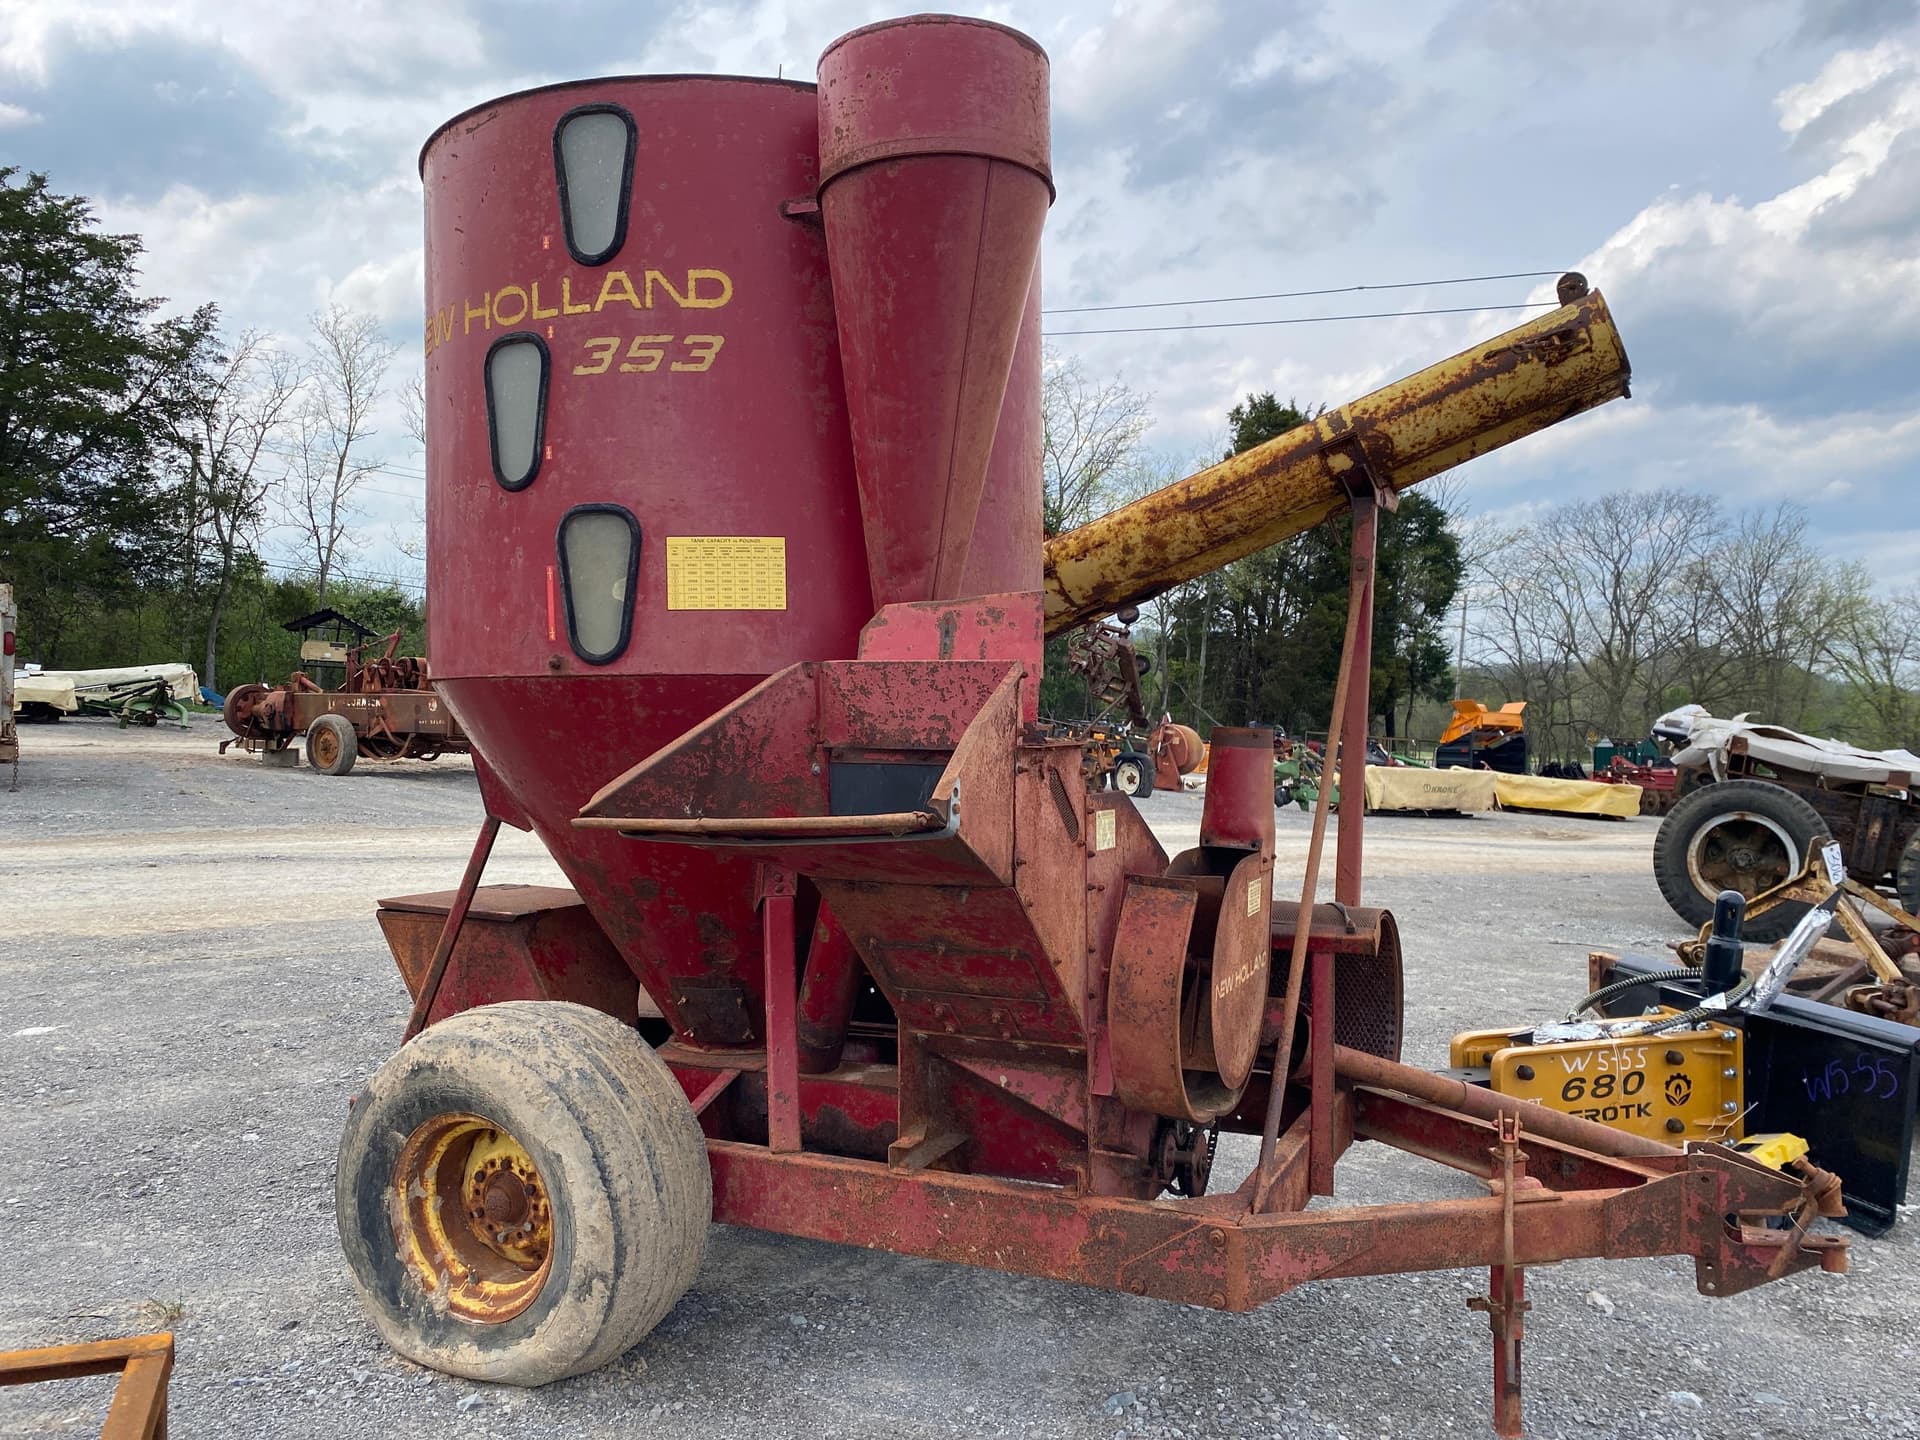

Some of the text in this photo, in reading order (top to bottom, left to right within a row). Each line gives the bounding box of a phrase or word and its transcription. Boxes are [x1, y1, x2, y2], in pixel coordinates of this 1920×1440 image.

[426, 268, 734, 358] EW HOLLAND
[572, 334, 725, 376] 353
[1216, 951, 1267, 1001] NEW HOLLAND
[1561, 1071, 1646, 1102] 680
